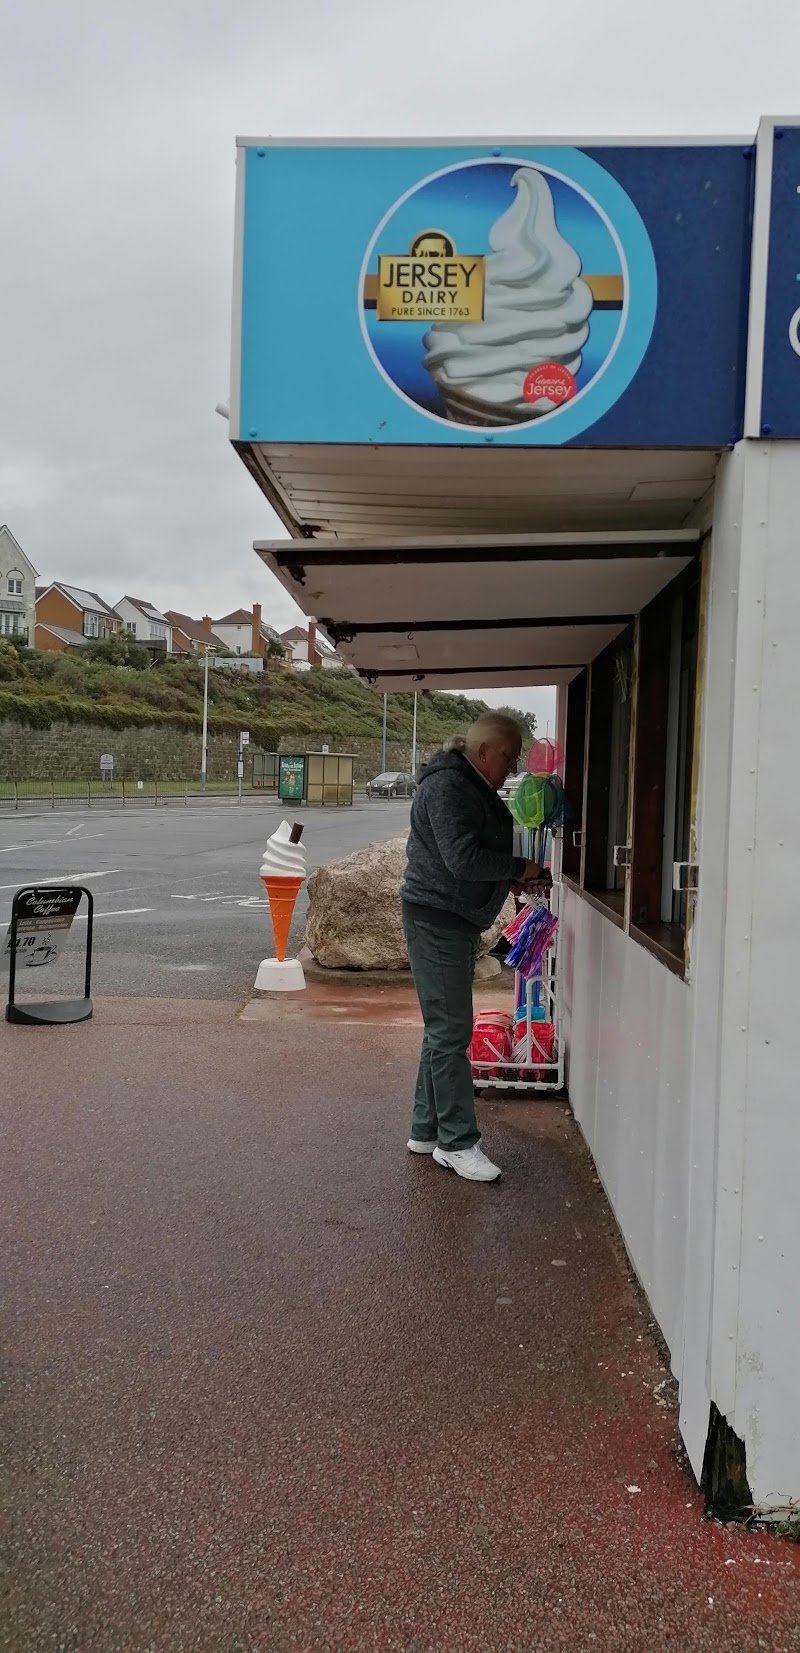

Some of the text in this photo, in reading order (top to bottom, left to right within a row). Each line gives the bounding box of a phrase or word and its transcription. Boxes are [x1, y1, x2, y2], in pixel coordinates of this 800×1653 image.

[383, 263, 477, 287] JERSEY
[402, 291, 458, 304] DAIRY
[391, 307, 470, 316] PURE SINCE 1763
[526, 383, 572, 398] Jersey
[25, 895, 73, 906] Columbian
[33, 904, 60, 915] Coffee
